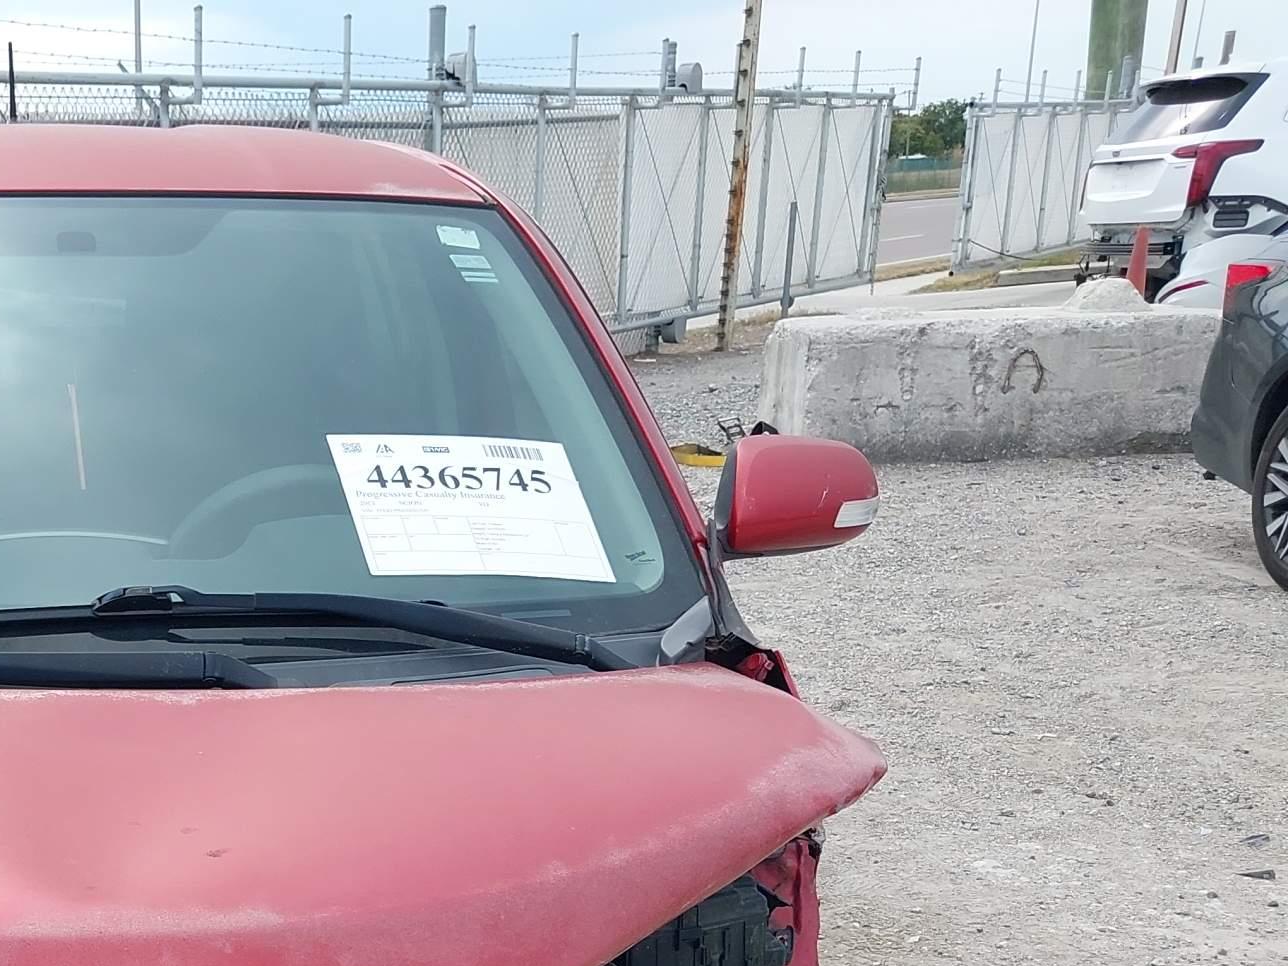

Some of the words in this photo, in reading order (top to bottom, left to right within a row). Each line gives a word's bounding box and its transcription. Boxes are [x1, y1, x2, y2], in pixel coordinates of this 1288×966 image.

[366, 464, 552, 494] 44365745
[355, 490, 413, 500] Progressive
[415, 490, 458, 501] Casualty
[460, 490, 506, 501] Insurance
